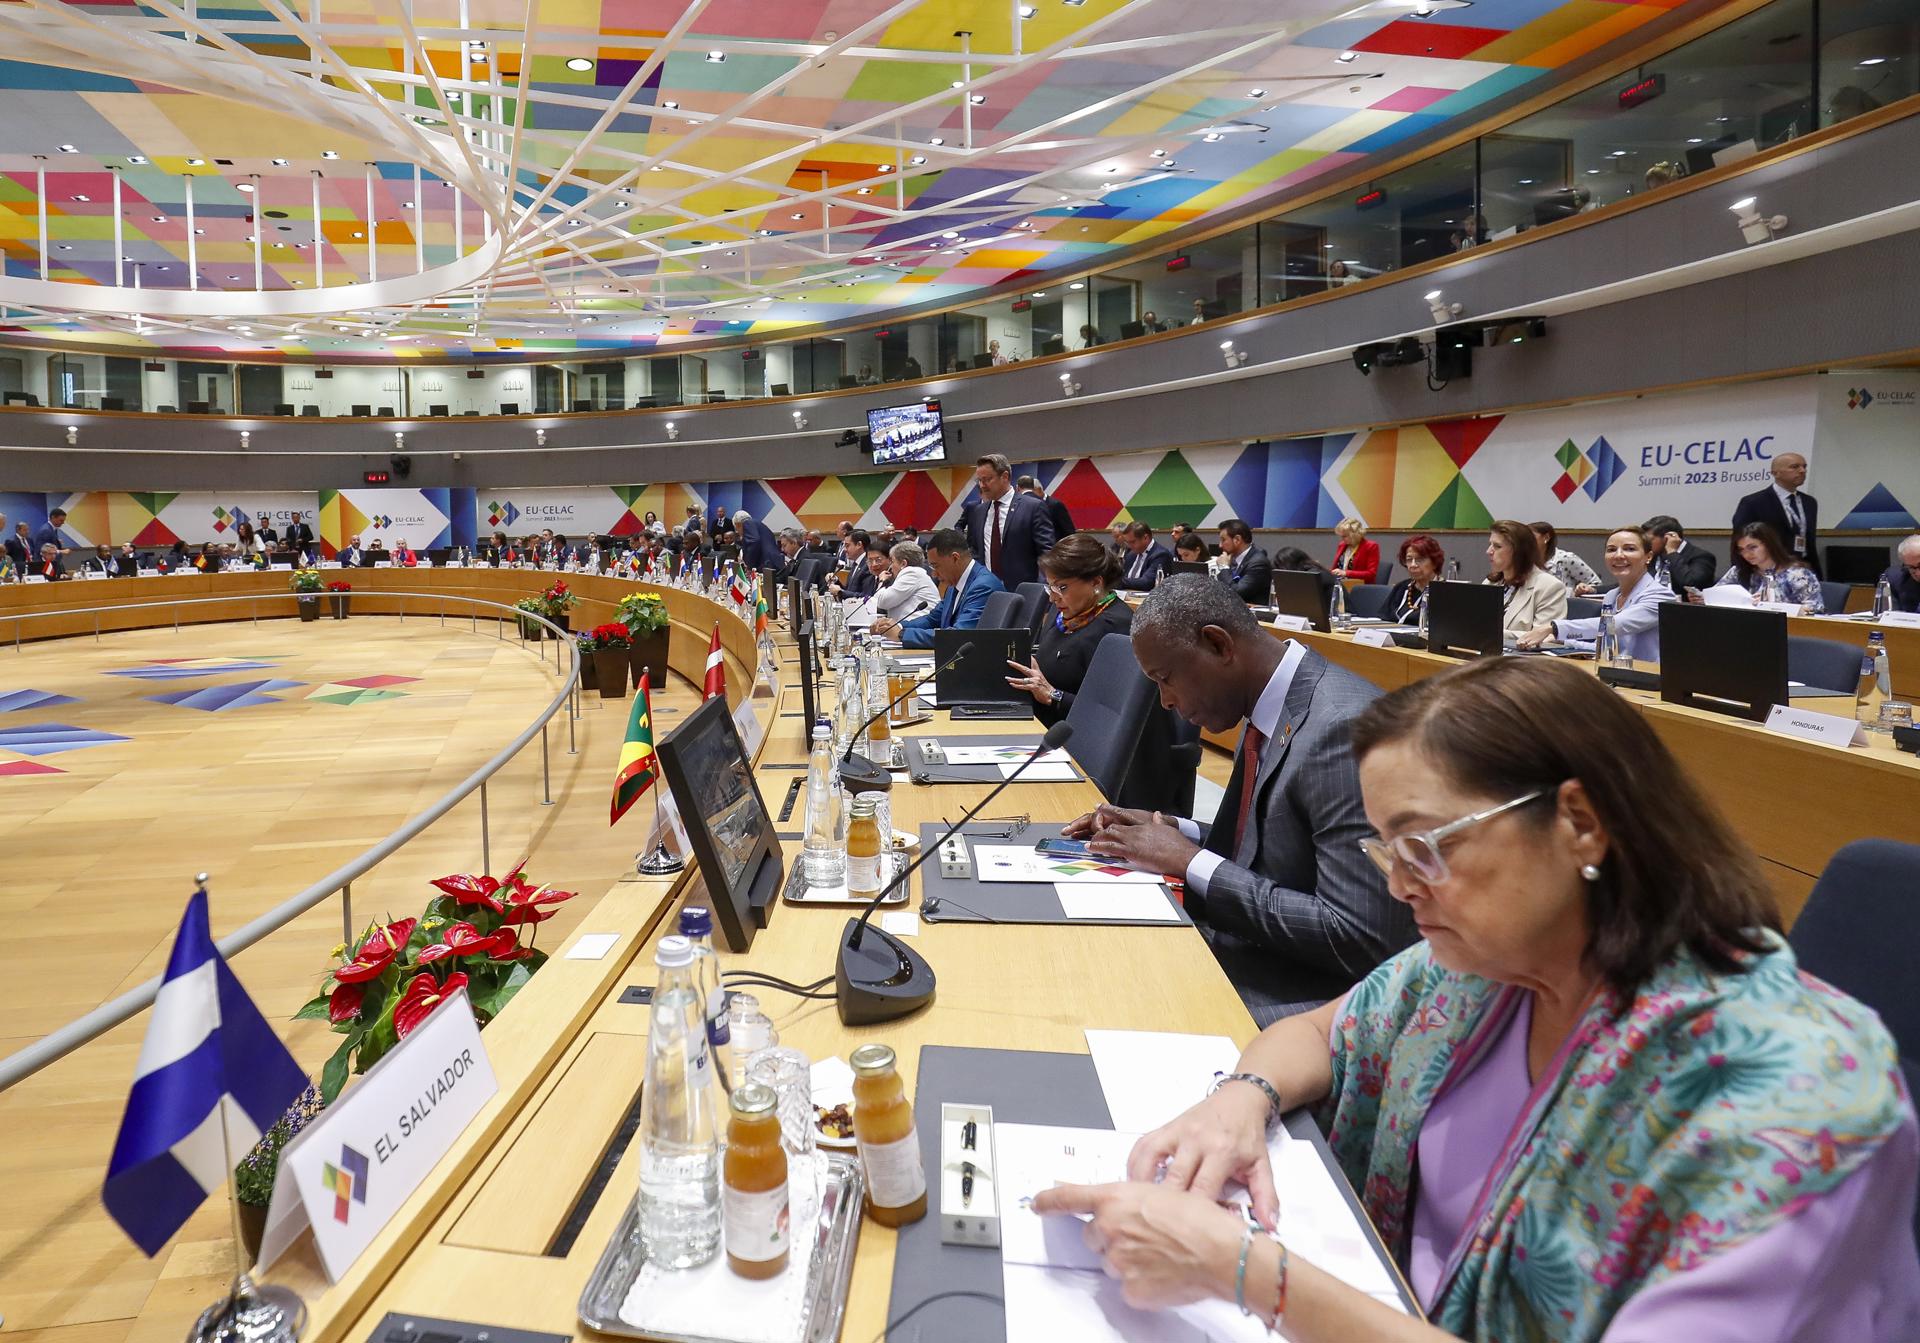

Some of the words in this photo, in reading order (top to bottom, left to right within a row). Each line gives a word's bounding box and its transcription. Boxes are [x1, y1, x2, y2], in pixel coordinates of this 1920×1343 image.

[1640, 435, 1775, 468] EU-CELAC
[1638, 473, 1681, 487] Summit
[1684, 471, 1718, 484] 2023
[1720, 468, 1772, 483] Brussels
[256, 510, 313, 520] EU-CEAC
[526, 505, 574, 514] EU-CELAC
[1790, 719, 1825, 733] HONDURAS
[374, 1132, 399, 1164] EL
[398, 1048, 474, 1138] SALVADOR
